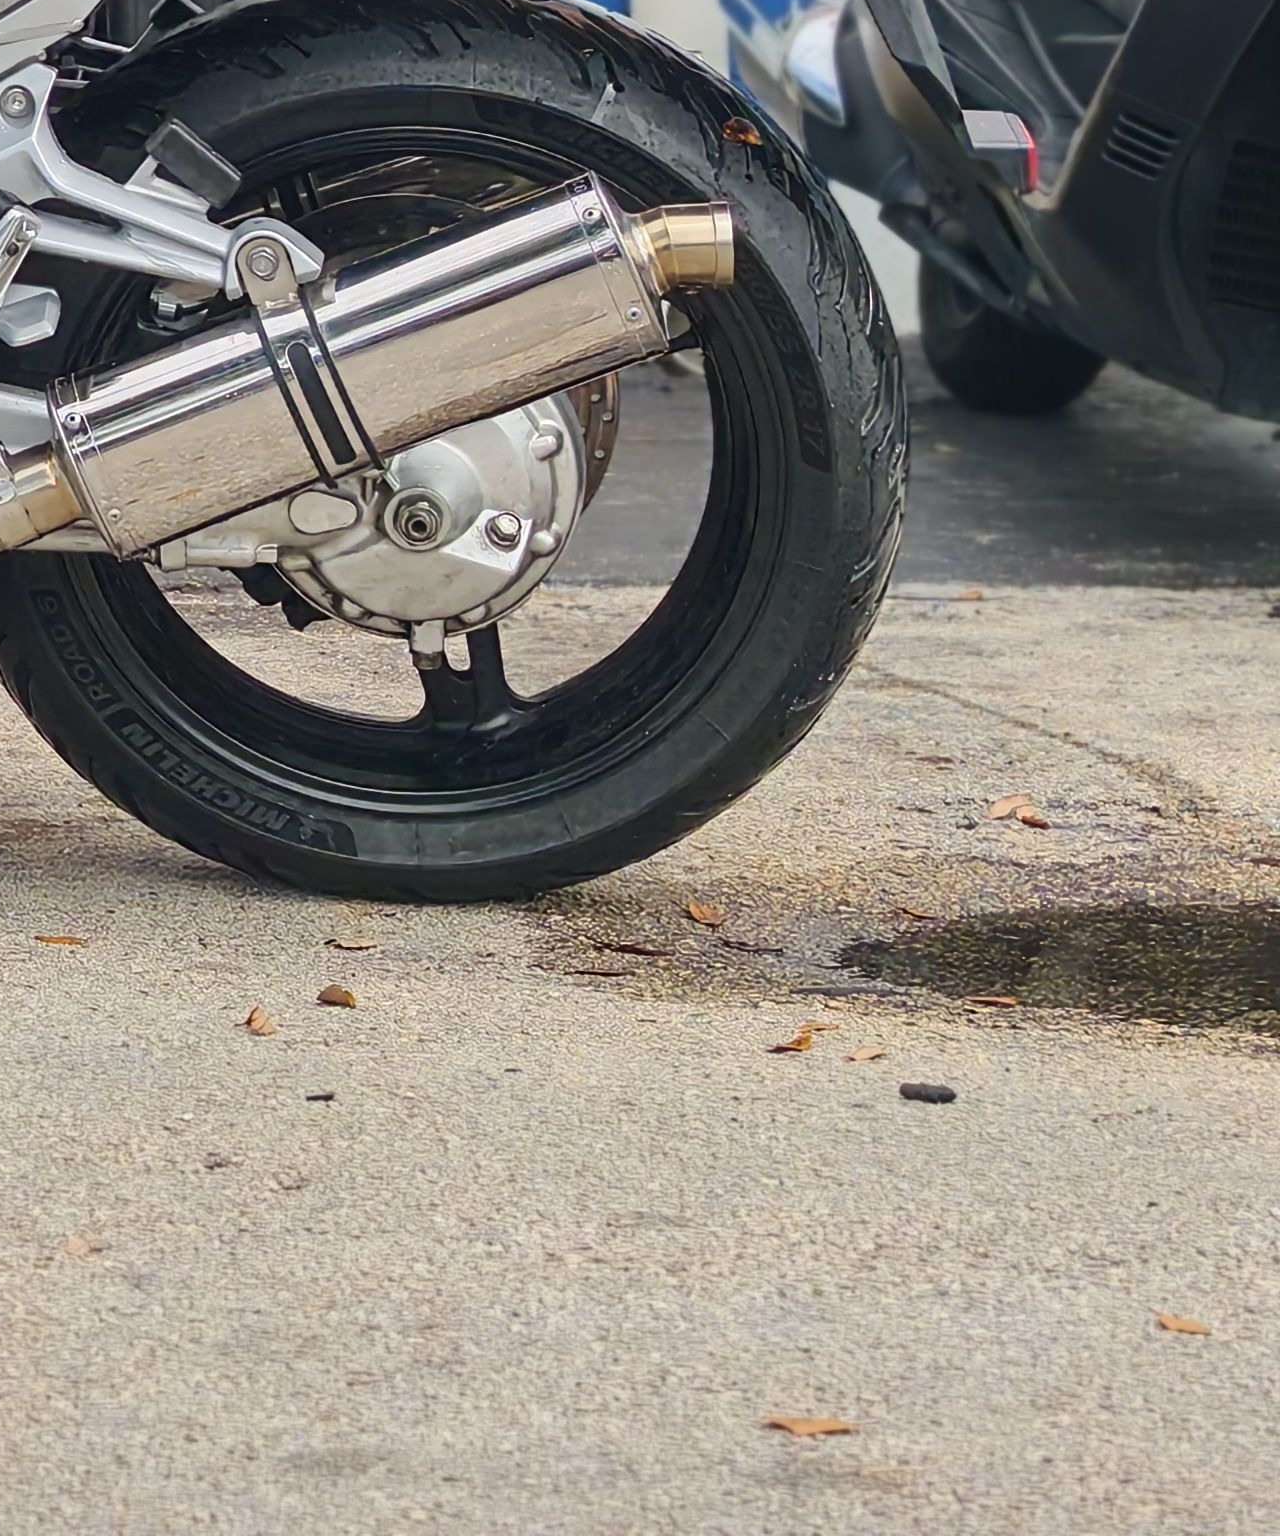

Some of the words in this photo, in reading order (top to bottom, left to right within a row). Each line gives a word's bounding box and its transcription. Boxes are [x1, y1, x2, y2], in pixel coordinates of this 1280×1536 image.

[39, 595, 58, 614] 6
[50, 624, 112, 703] ROAD
[121, 721, 290, 832] MICHELIN
